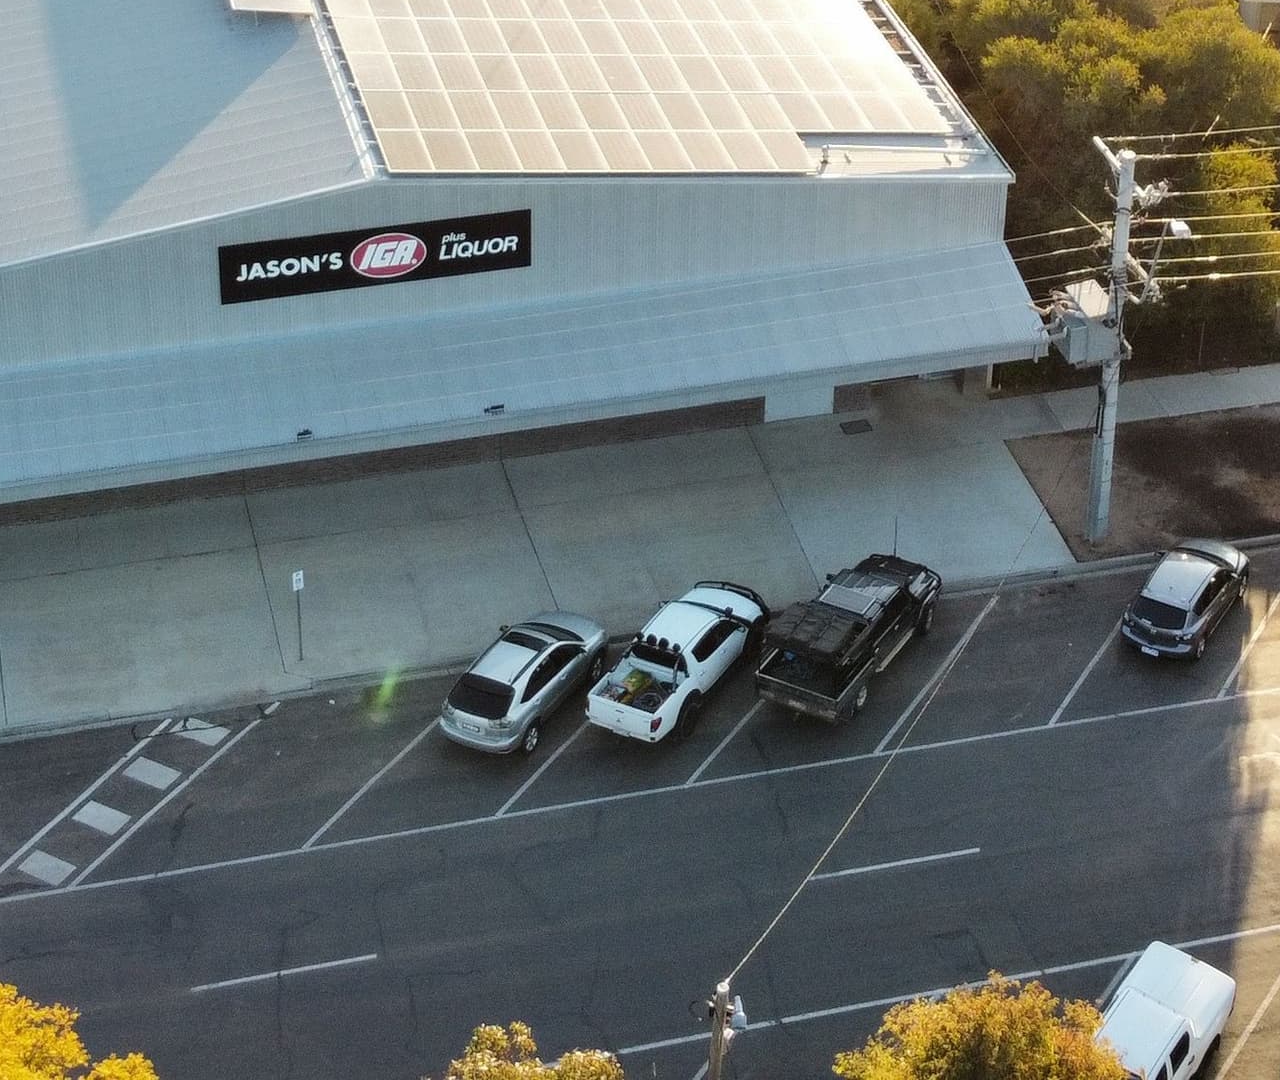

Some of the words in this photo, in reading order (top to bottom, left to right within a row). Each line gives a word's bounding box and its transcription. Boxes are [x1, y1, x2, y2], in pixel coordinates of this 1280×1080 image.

[439, 235, 519, 261] LIQUOR
[441, 232, 467, 245] plus
[235, 252, 344, 282] JASON'S
[358, 239, 418, 270] IGA
